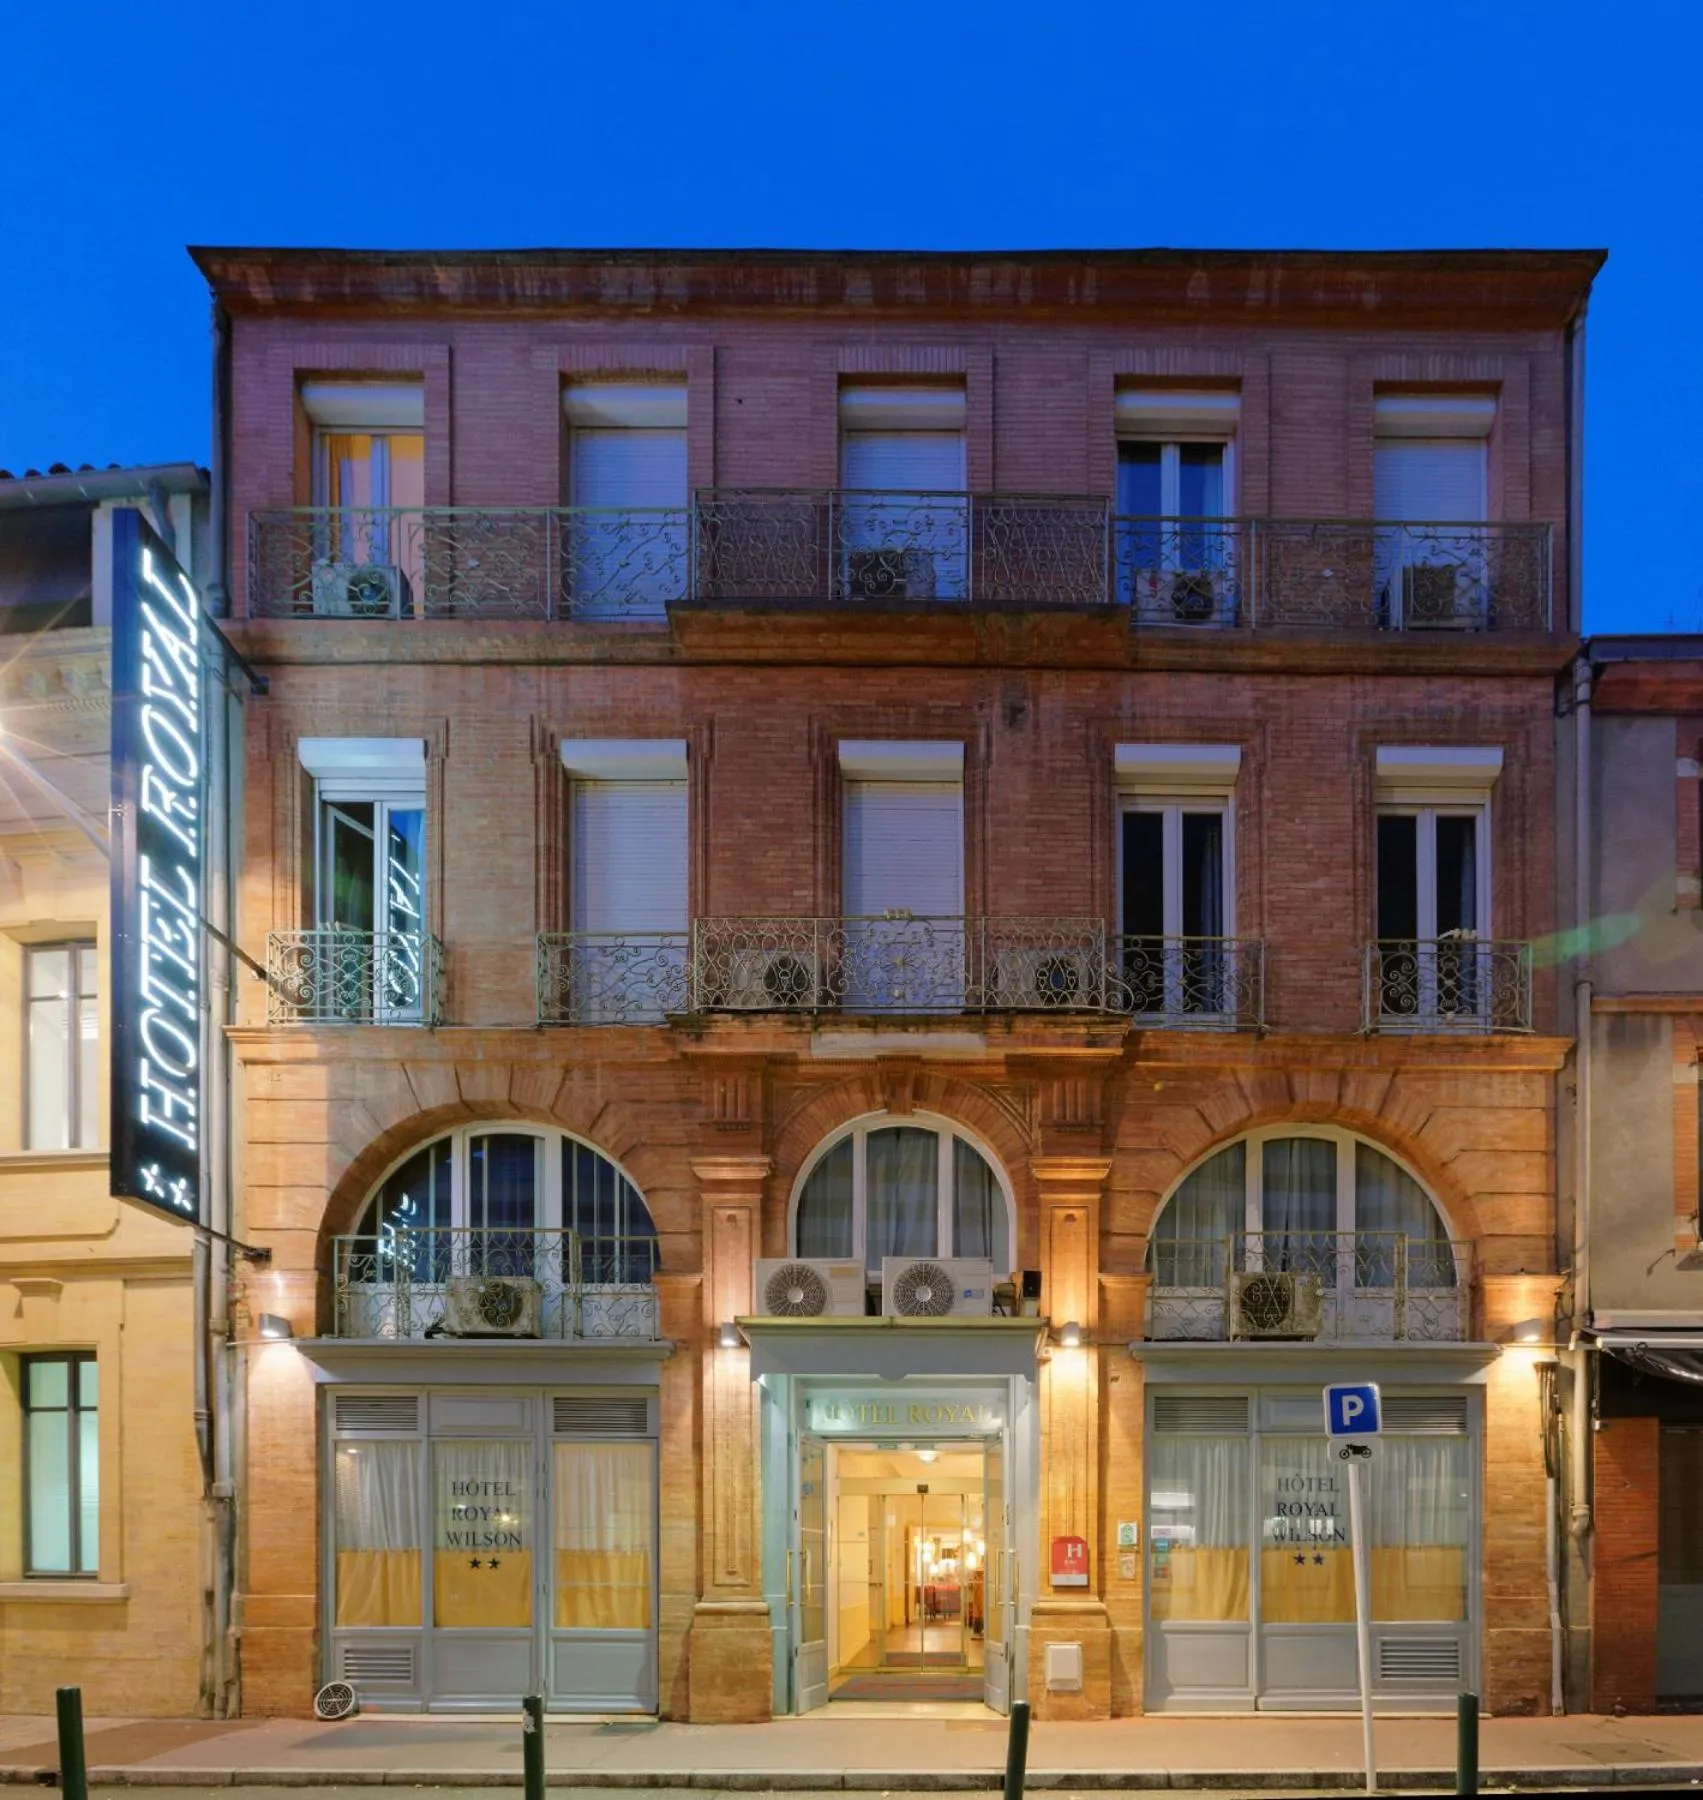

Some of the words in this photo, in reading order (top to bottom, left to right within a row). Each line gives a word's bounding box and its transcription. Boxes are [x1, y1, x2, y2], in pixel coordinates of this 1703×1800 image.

[139, 546, 200, 859] ROYAL
[139, 853, 197, 1151] HOTEL
[907, 1402, 991, 1425] ROYAL
[1341, 1394, 1365, 1426] P
[451, 1477, 516, 1497] HÔTEL
[1277, 1473, 1340, 1492] HÔTEL
[1276, 1501, 1341, 1517] ROYAL
[446, 1531, 523, 1547] WILSON
[1272, 1527, 1346, 1542] WILSON
[1067, 1543, 1083, 1558] H
